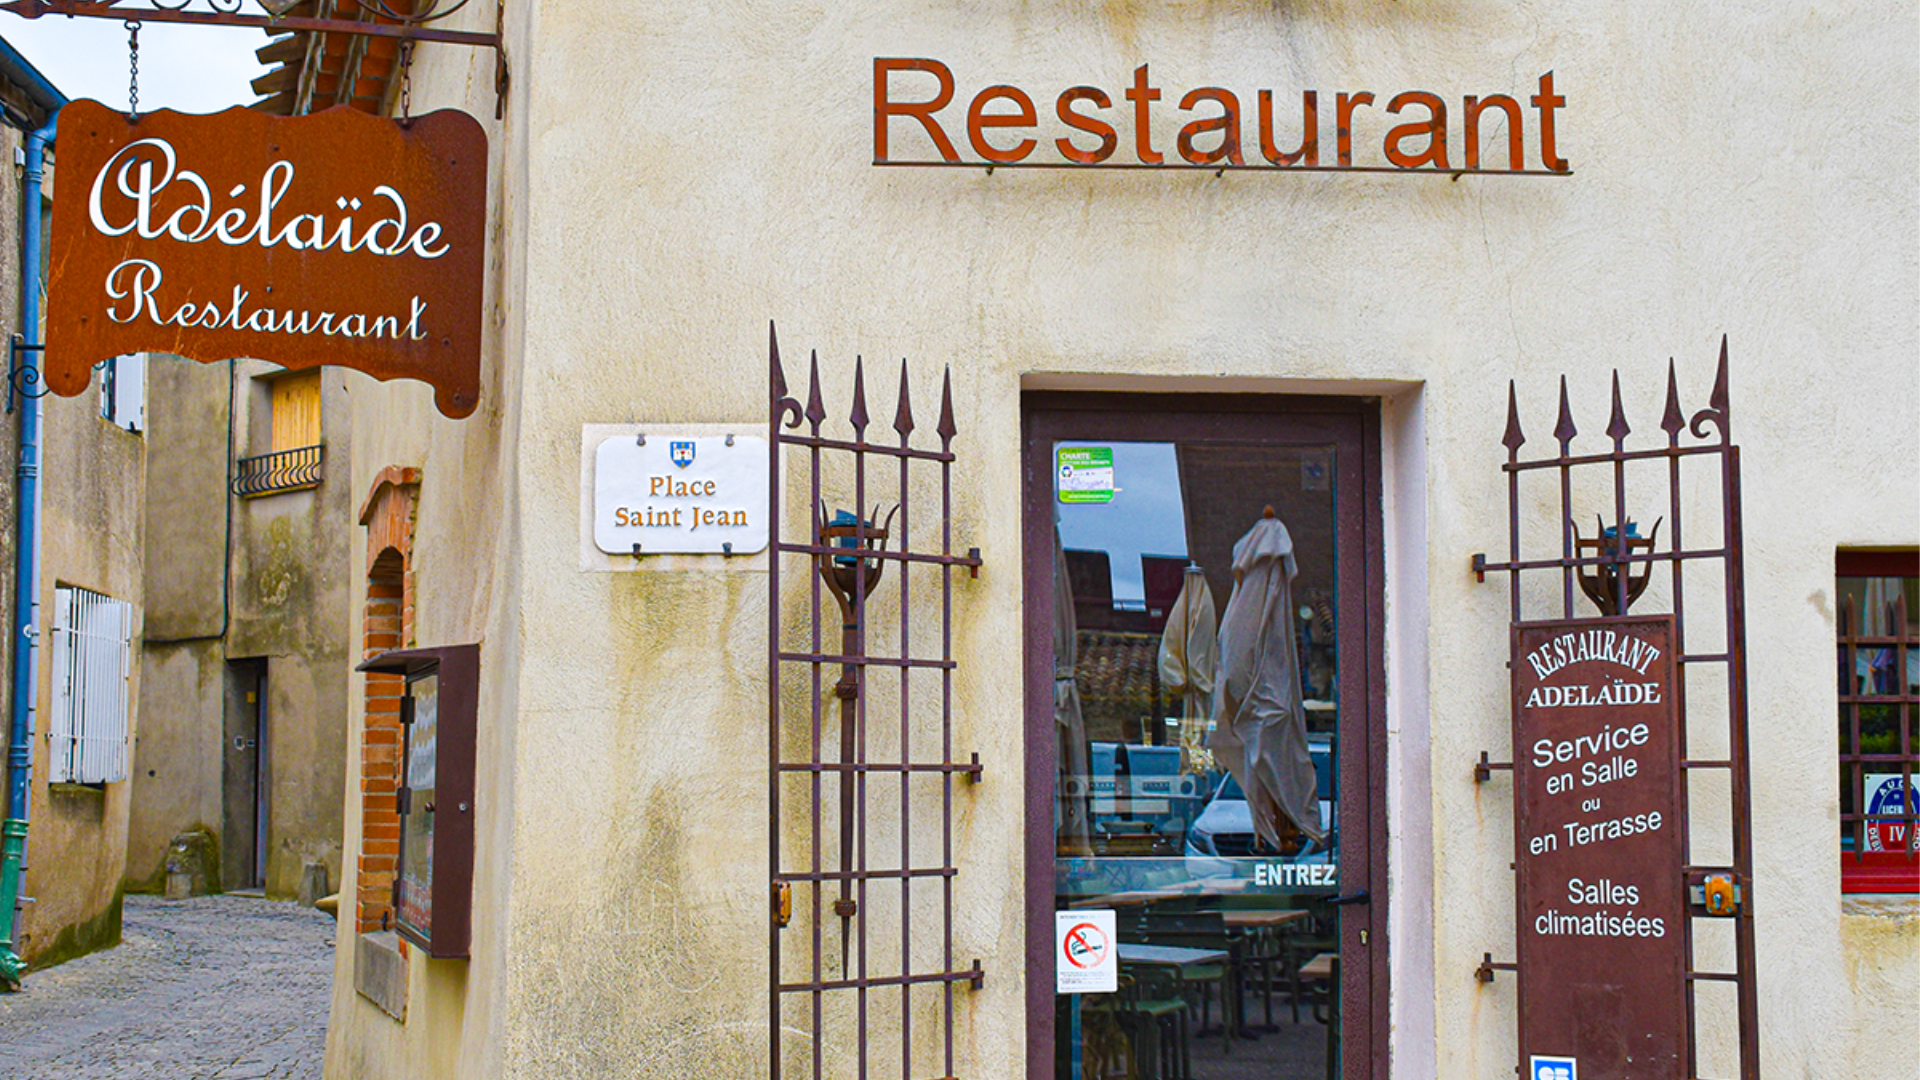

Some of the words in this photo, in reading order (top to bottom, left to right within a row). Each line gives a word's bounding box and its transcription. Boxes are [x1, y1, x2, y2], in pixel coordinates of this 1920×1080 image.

[873, 56, 1568, 171] Restaurant
[88, 137, 450, 260] Adélaïde
[104, 258, 428, 341] Restaurant
[649, 475, 716, 497] Place
[615, 506, 682, 528] Saint
[690, 506, 748, 532] Jean
[1527, 630, 1661, 681] RESTAURANT
[1532, 723, 1649, 768] Service
[1546, 772, 1574, 795] en
[1581, 755, 1638, 787] Salle
[1581, 797, 1601, 813] ou
[1529, 833, 1557, 856] en
[1563, 810, 1662, 847] Terrasse
[1889, 825, 1906, 842] IV
[1255, 863, 1336, 886] ENTREZ
[1567, 877, 1640, 905] Salles
[1535, 909, 1665, 938] climatisées
